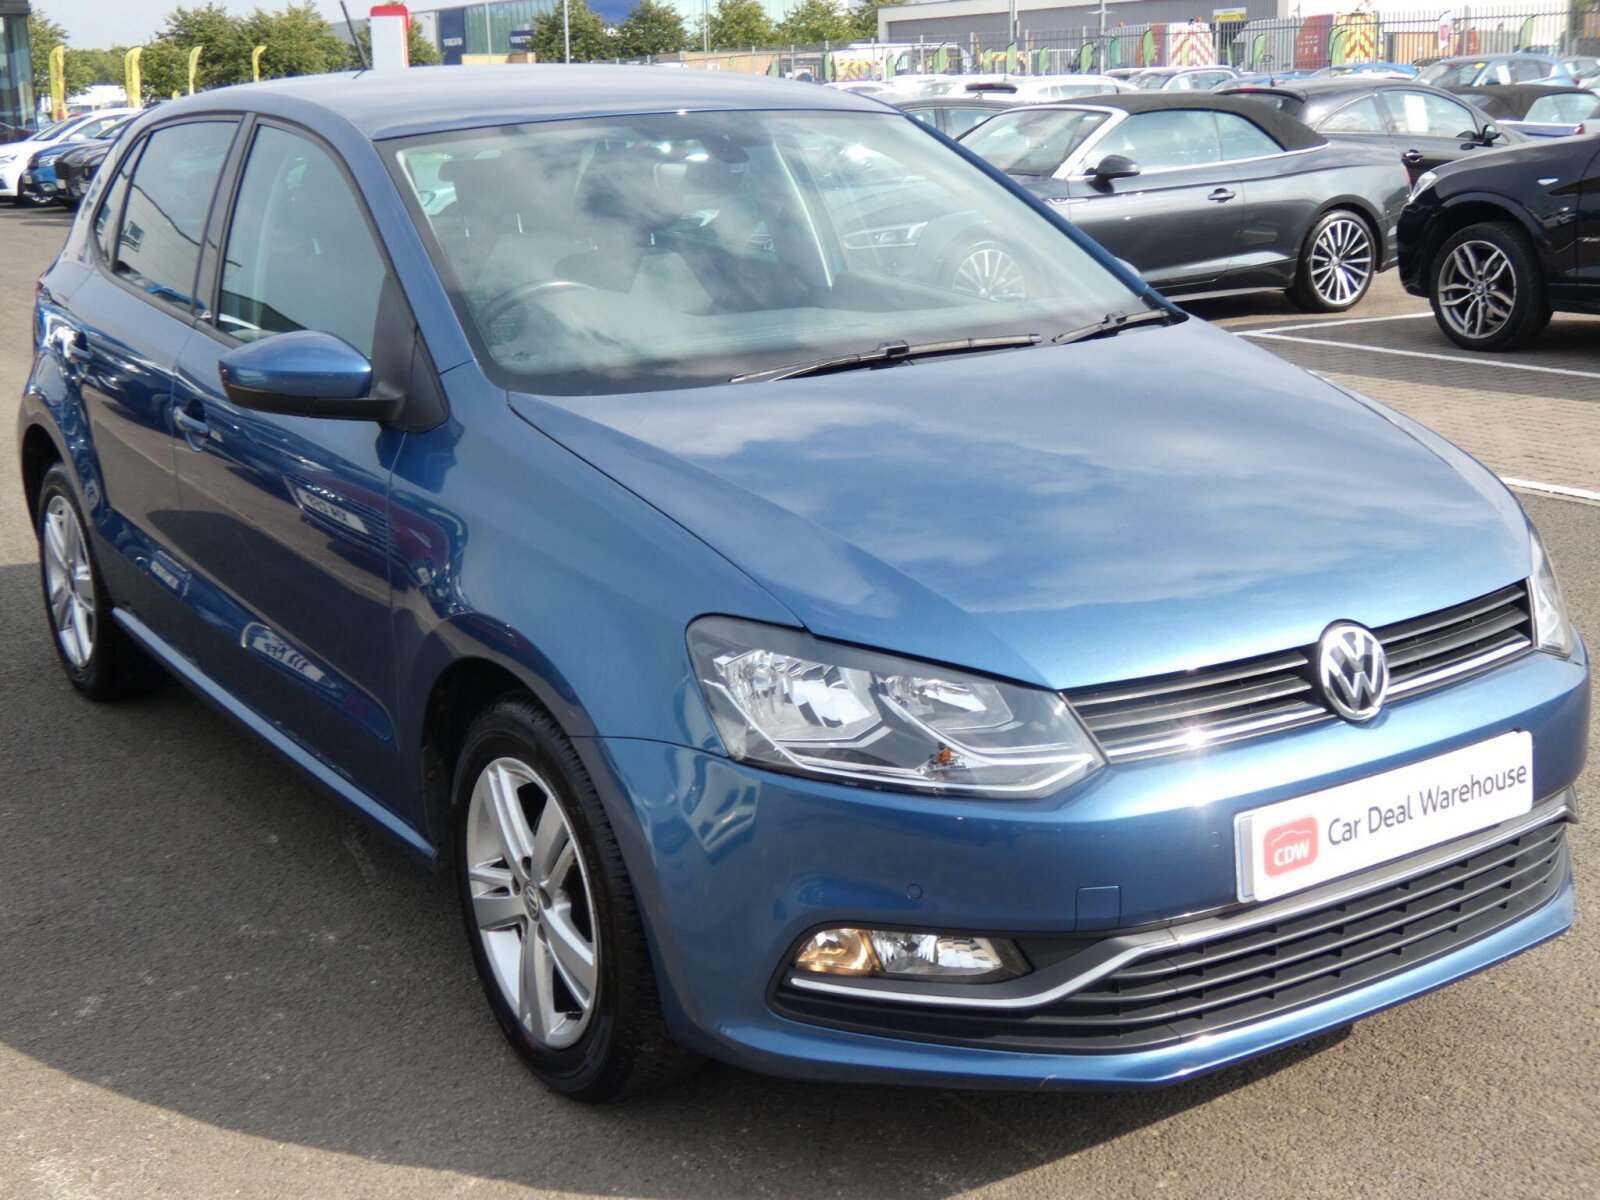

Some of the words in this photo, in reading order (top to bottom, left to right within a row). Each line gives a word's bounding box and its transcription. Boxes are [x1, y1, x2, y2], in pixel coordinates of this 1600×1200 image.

[1328, 817, 1362, 846] Car
[1368, 794, 1413, 834] Deal
[1419, 764, 1528, 816] Warehouse
[1273, 840, 1310, 867] CDW
